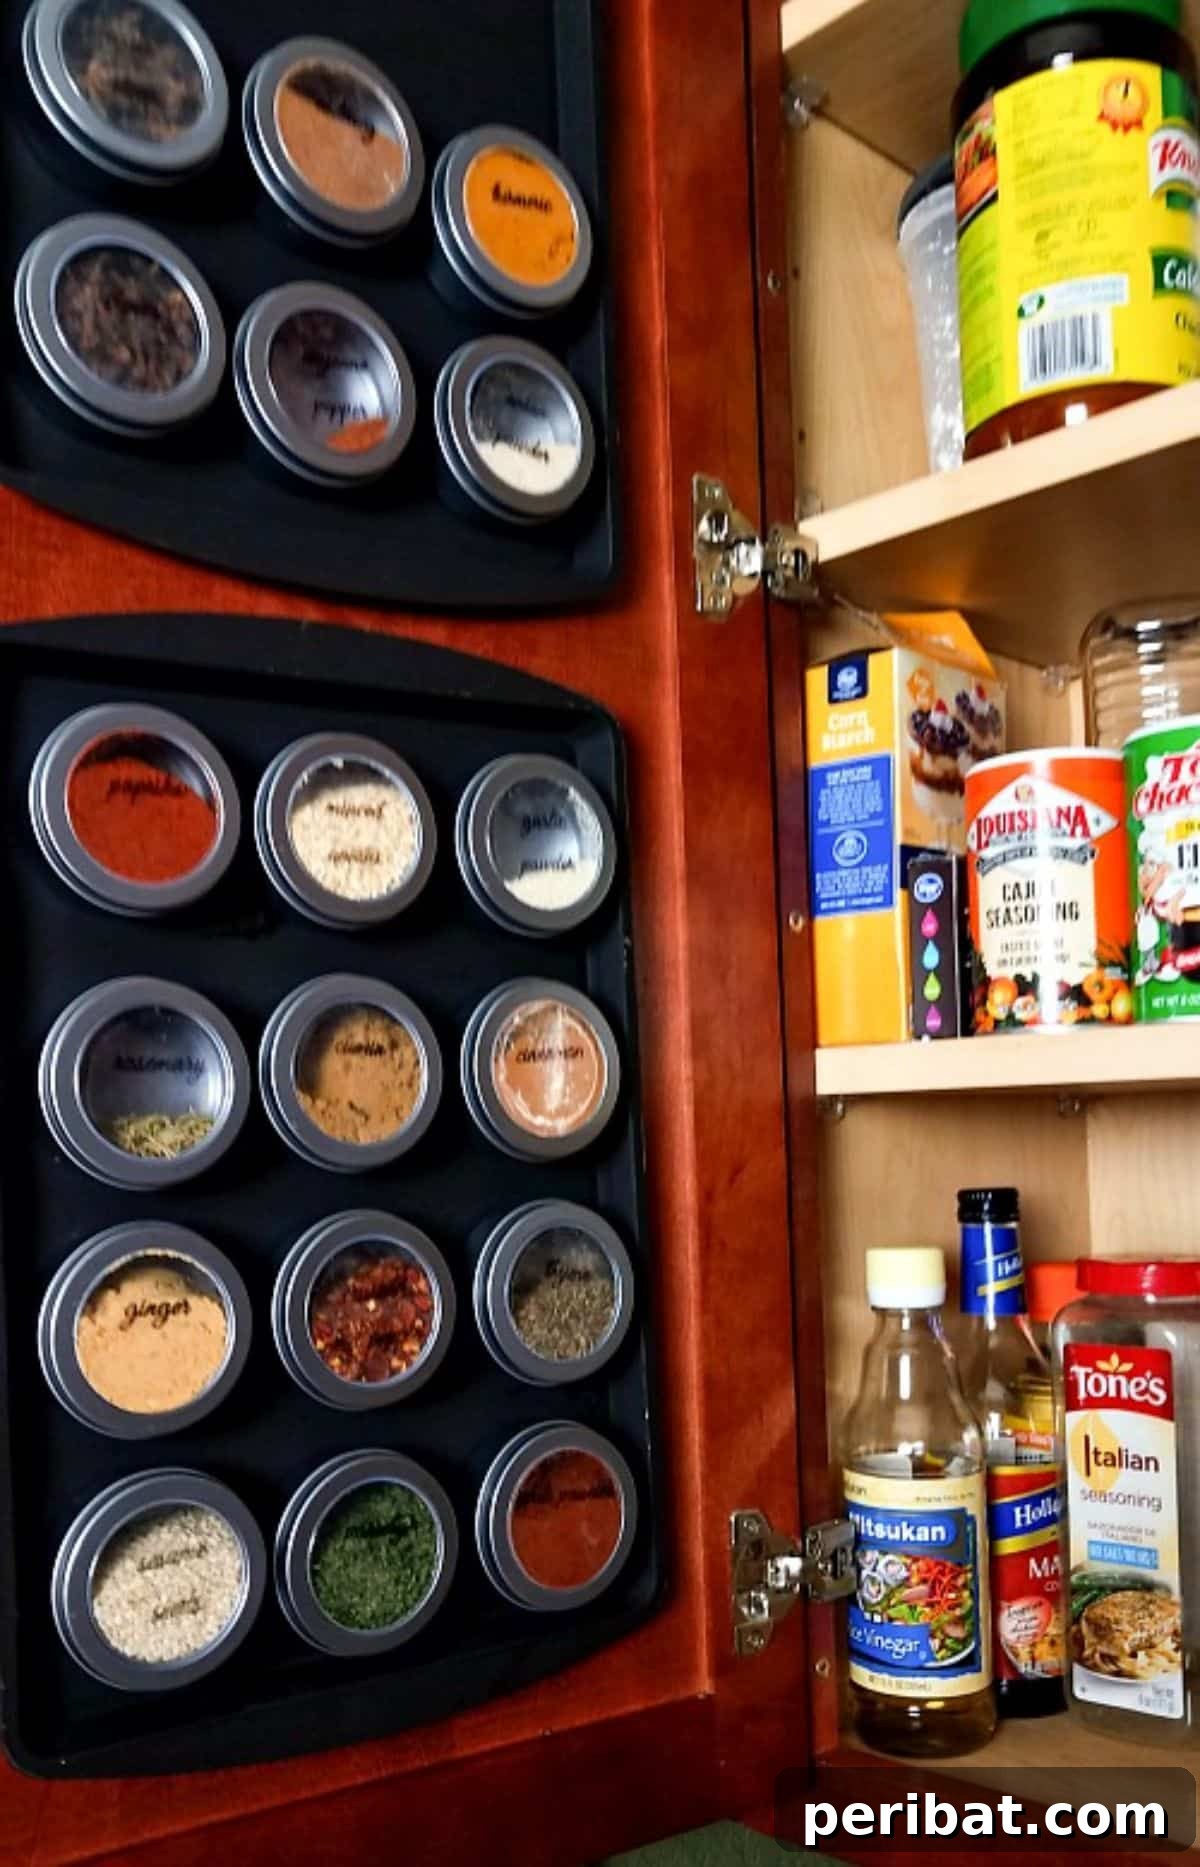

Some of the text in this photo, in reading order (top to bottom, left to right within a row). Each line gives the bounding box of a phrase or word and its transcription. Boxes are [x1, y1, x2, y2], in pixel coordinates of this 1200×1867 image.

[118, 1299, 193, 1332] ginger
[1083, 1433, 1160, 1478] Italian
[1080, 1489, 1163, 1513] seasoning
[863, 1626, 921, 1660] Vinegar
